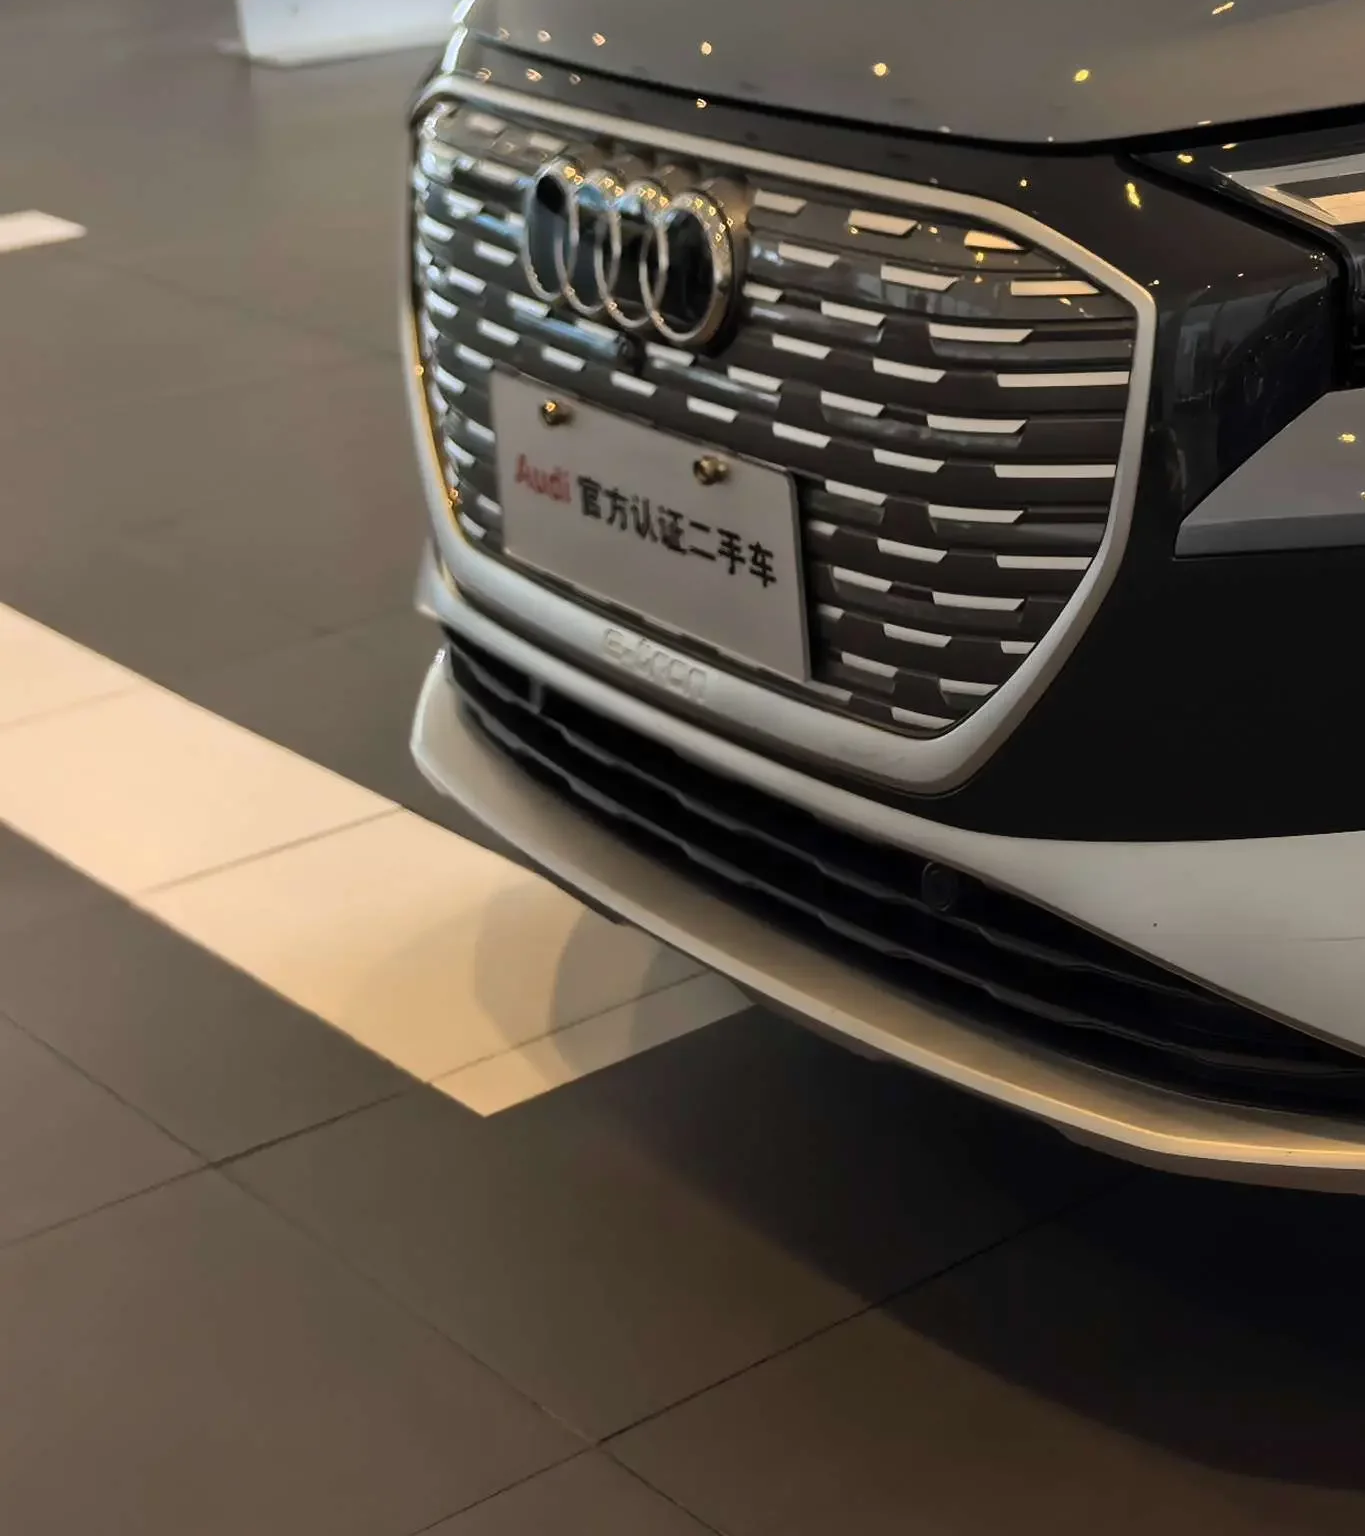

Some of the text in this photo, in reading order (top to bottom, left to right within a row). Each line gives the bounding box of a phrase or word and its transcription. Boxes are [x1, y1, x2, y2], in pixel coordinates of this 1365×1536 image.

[514, 453, 777, 588] Audi 官方认证二手车
